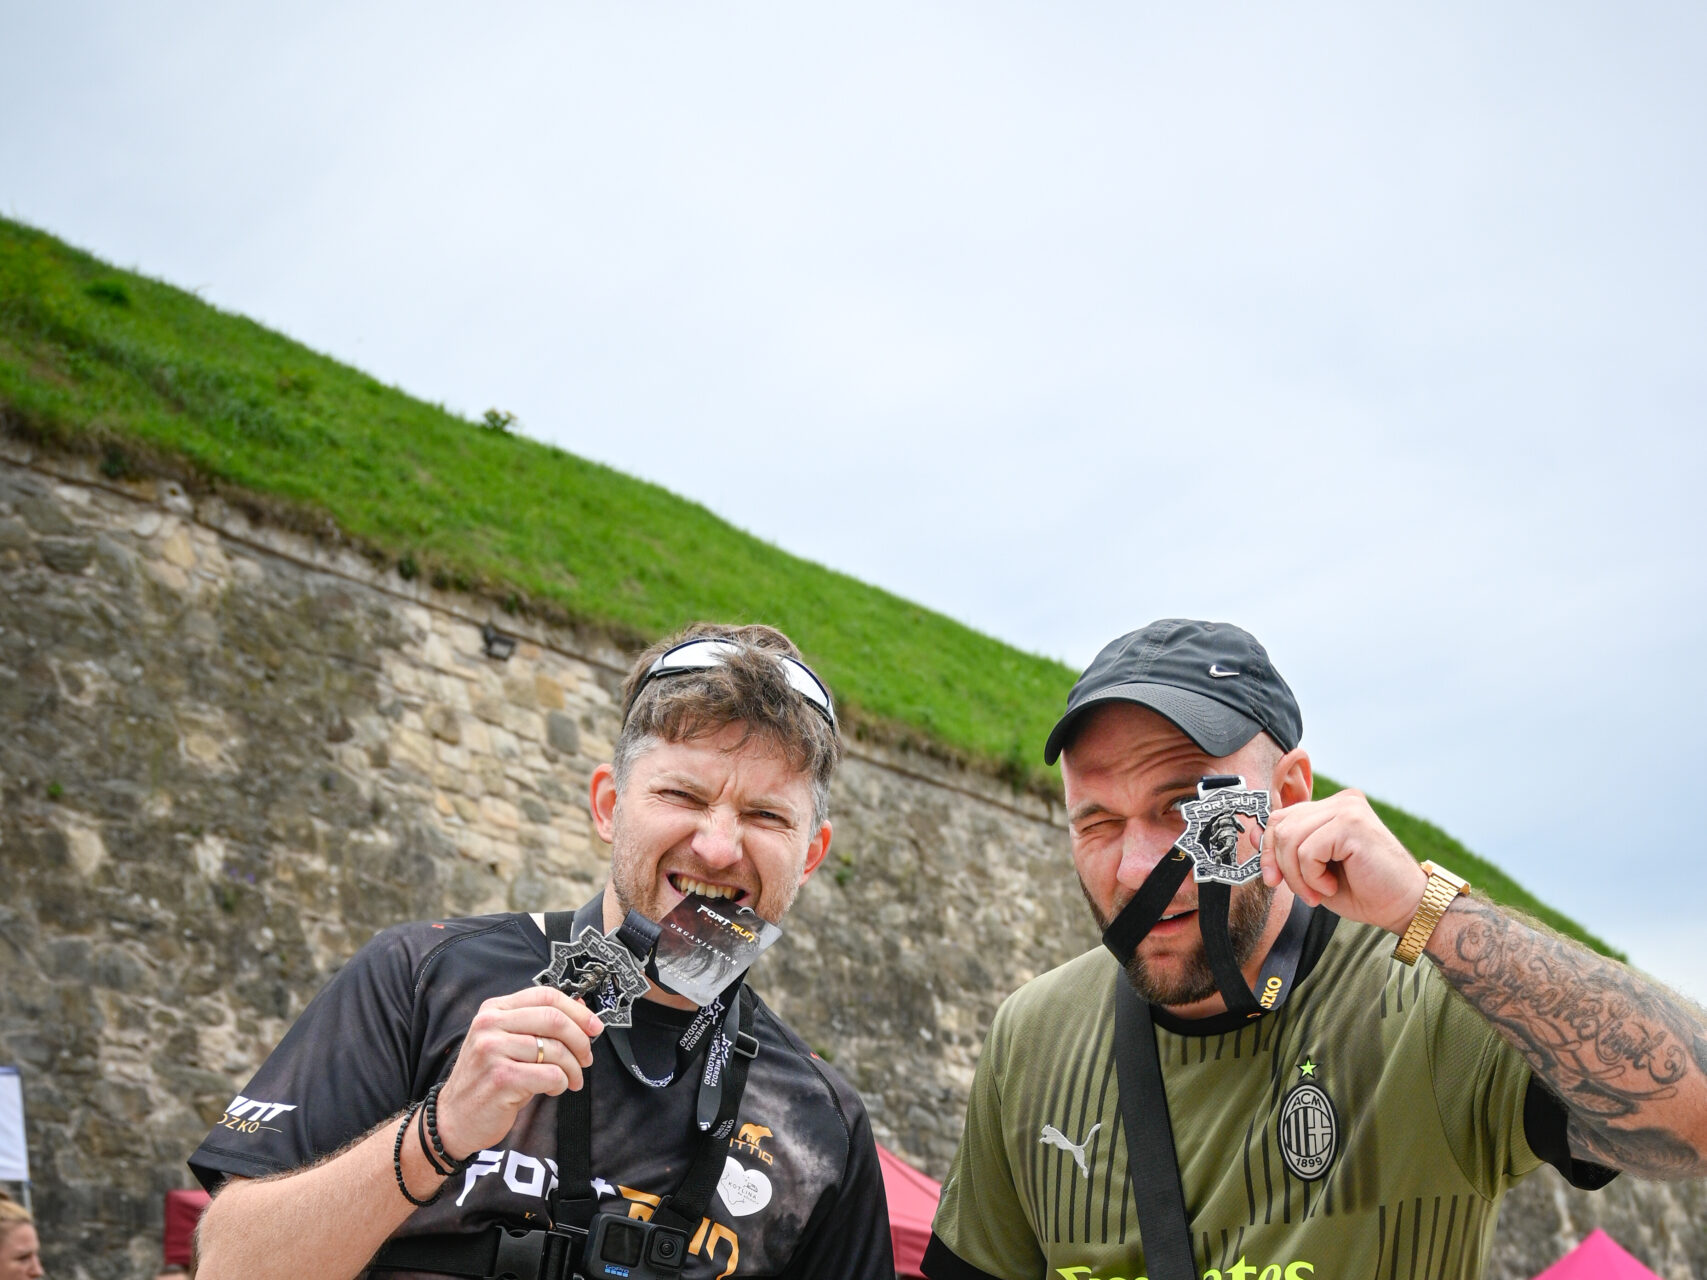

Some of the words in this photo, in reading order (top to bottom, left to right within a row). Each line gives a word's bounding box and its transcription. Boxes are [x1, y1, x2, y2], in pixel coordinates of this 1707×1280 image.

[1191, 795, 1227, 818] FORT
[696, 904, 731, 926] FORT
[730, 922, 756, 943] RUN
[670, 923, 738, 966] ORGANIZATOR
[679, 1013, 705, 1047] KŁODZKO
[684, 1017, 711, 1052] TWIERDZA
[704, 1052, 717, 1085] KŁODZKO
[1291, 1092, 1323, 1109] ACM
[1296, 1155, 1324, 1169] 1899
